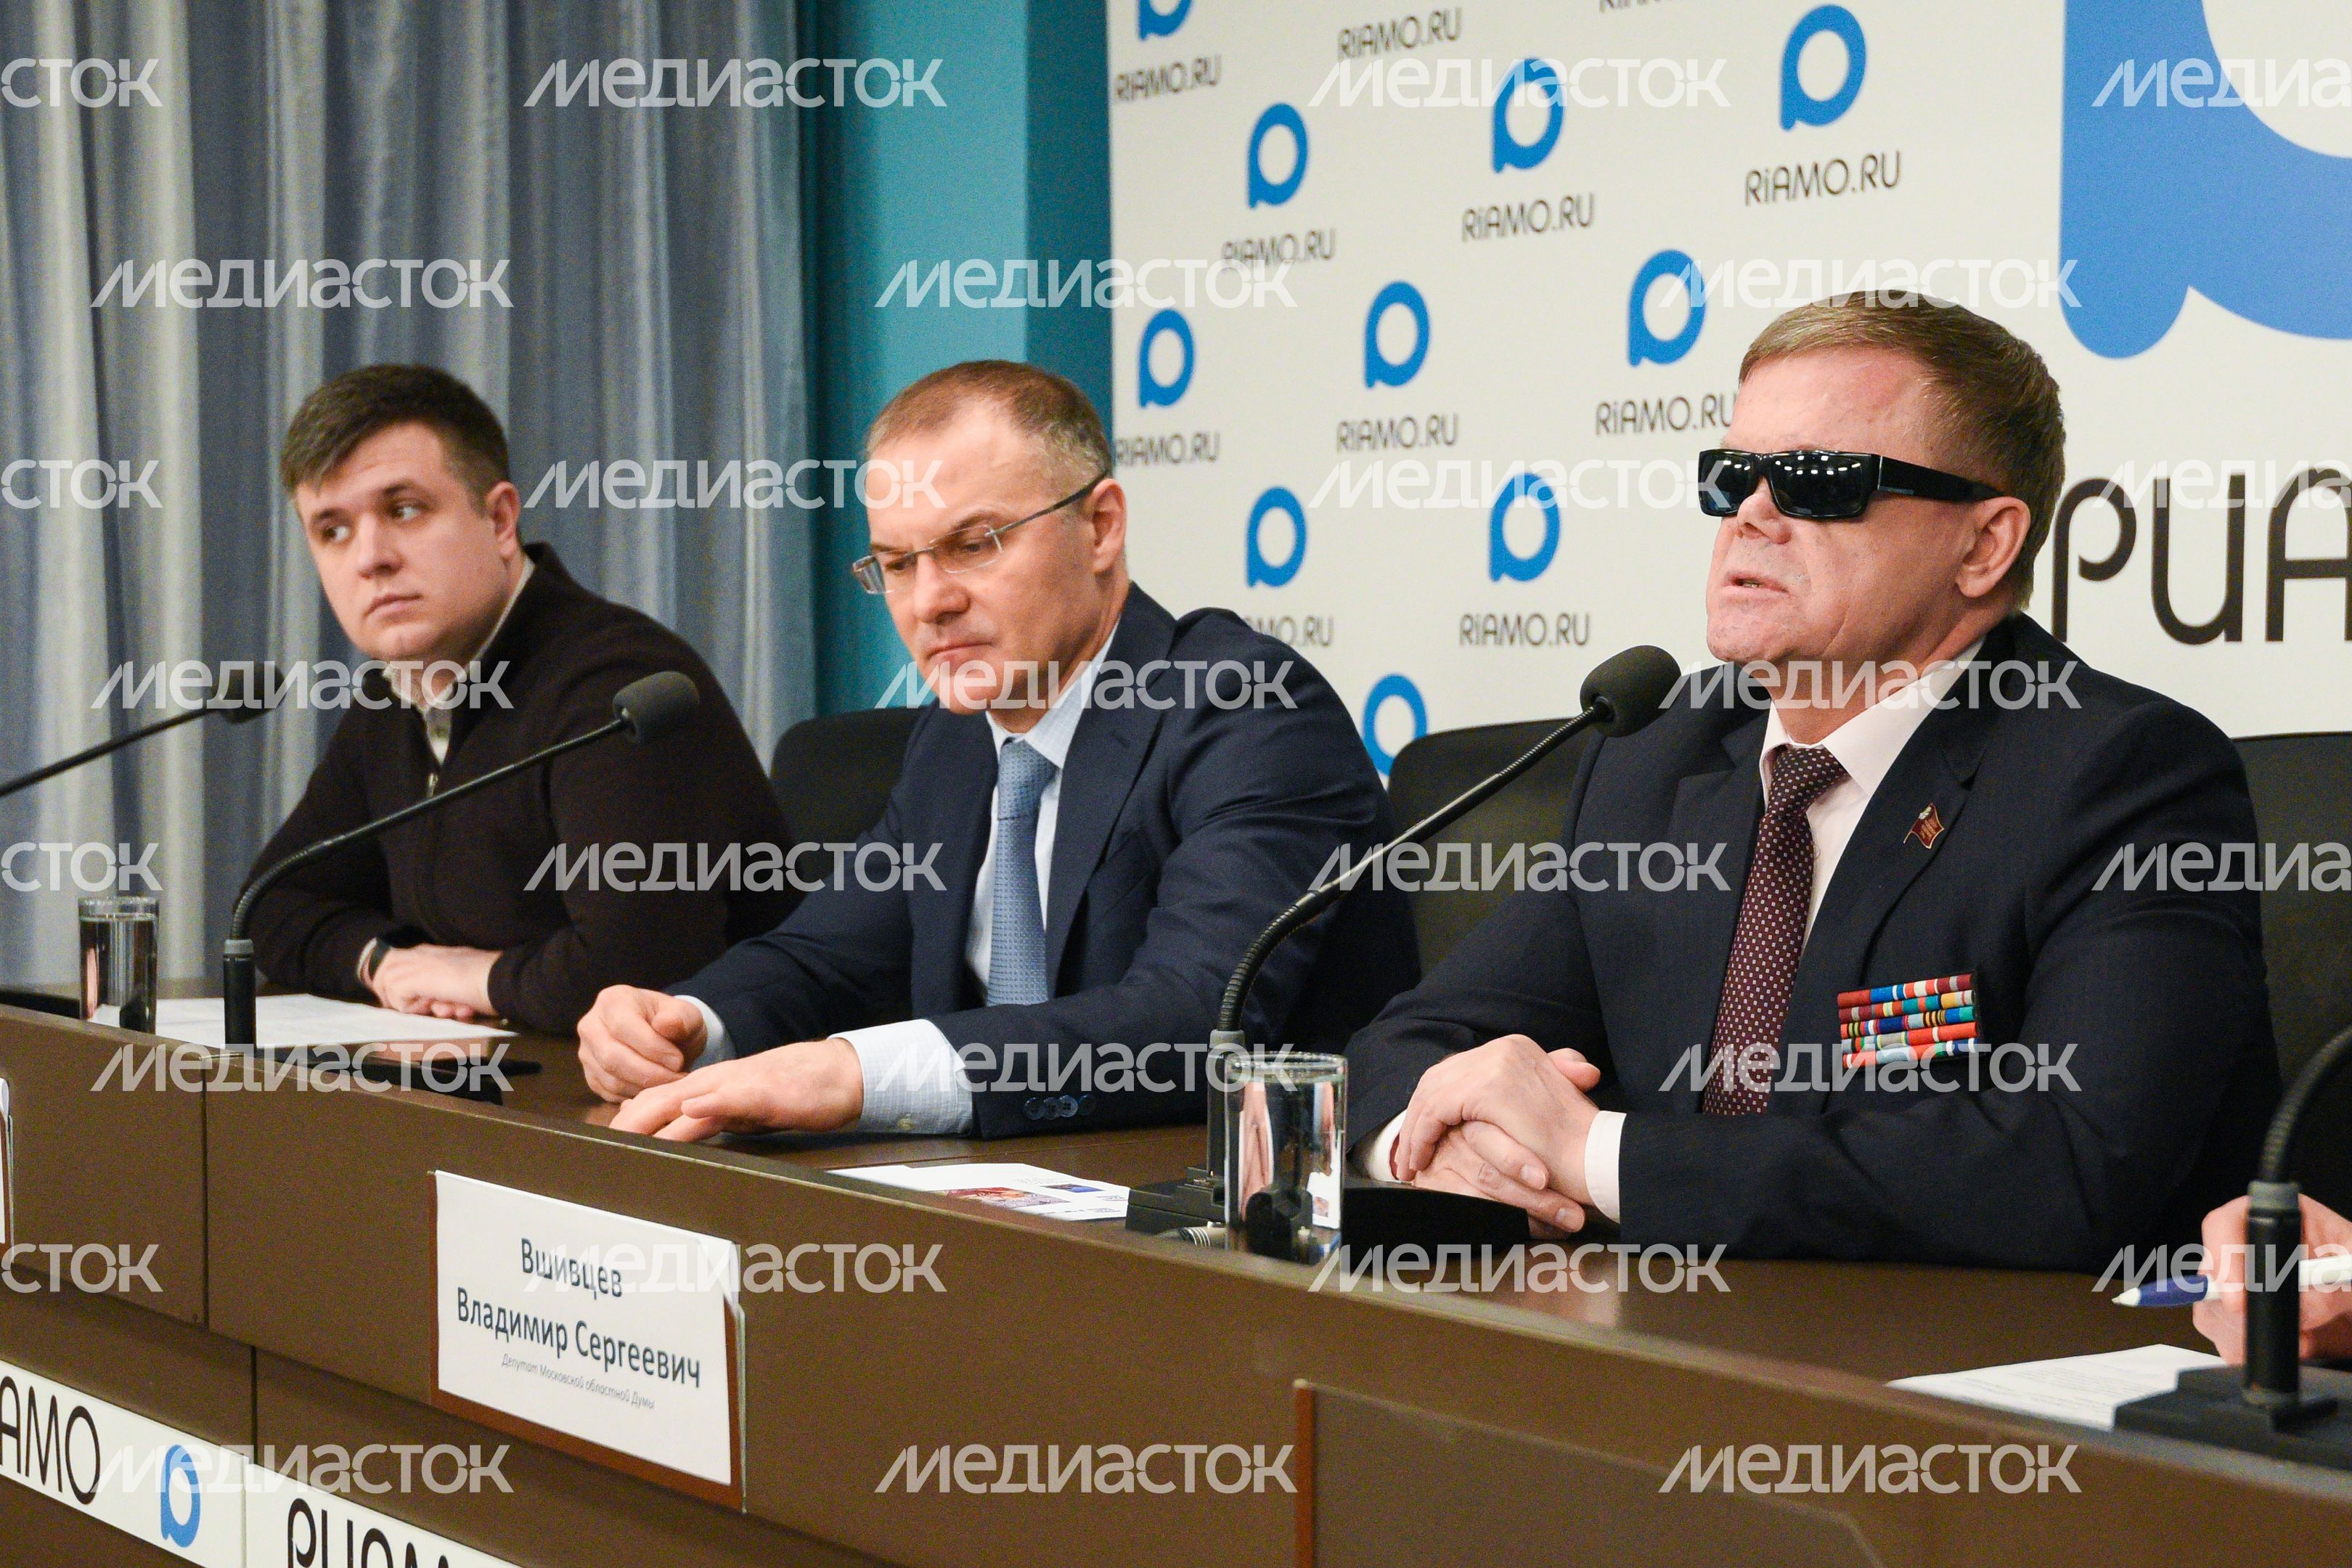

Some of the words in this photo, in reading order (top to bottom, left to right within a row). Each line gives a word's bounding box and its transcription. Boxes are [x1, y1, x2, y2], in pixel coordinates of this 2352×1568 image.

[520, 1237, 623, 1300] Вшивцев
[457, 1286, 568, 1359] Владимир
[575, 1320, 701, 1388] Сергеевич
[501, 1352, 539, 1374] Депутат
[539, 1363, 584, 1389] Московской
[585, 1379, 630, 1403] областной
[631, 1390, 656, 1410] Думы
